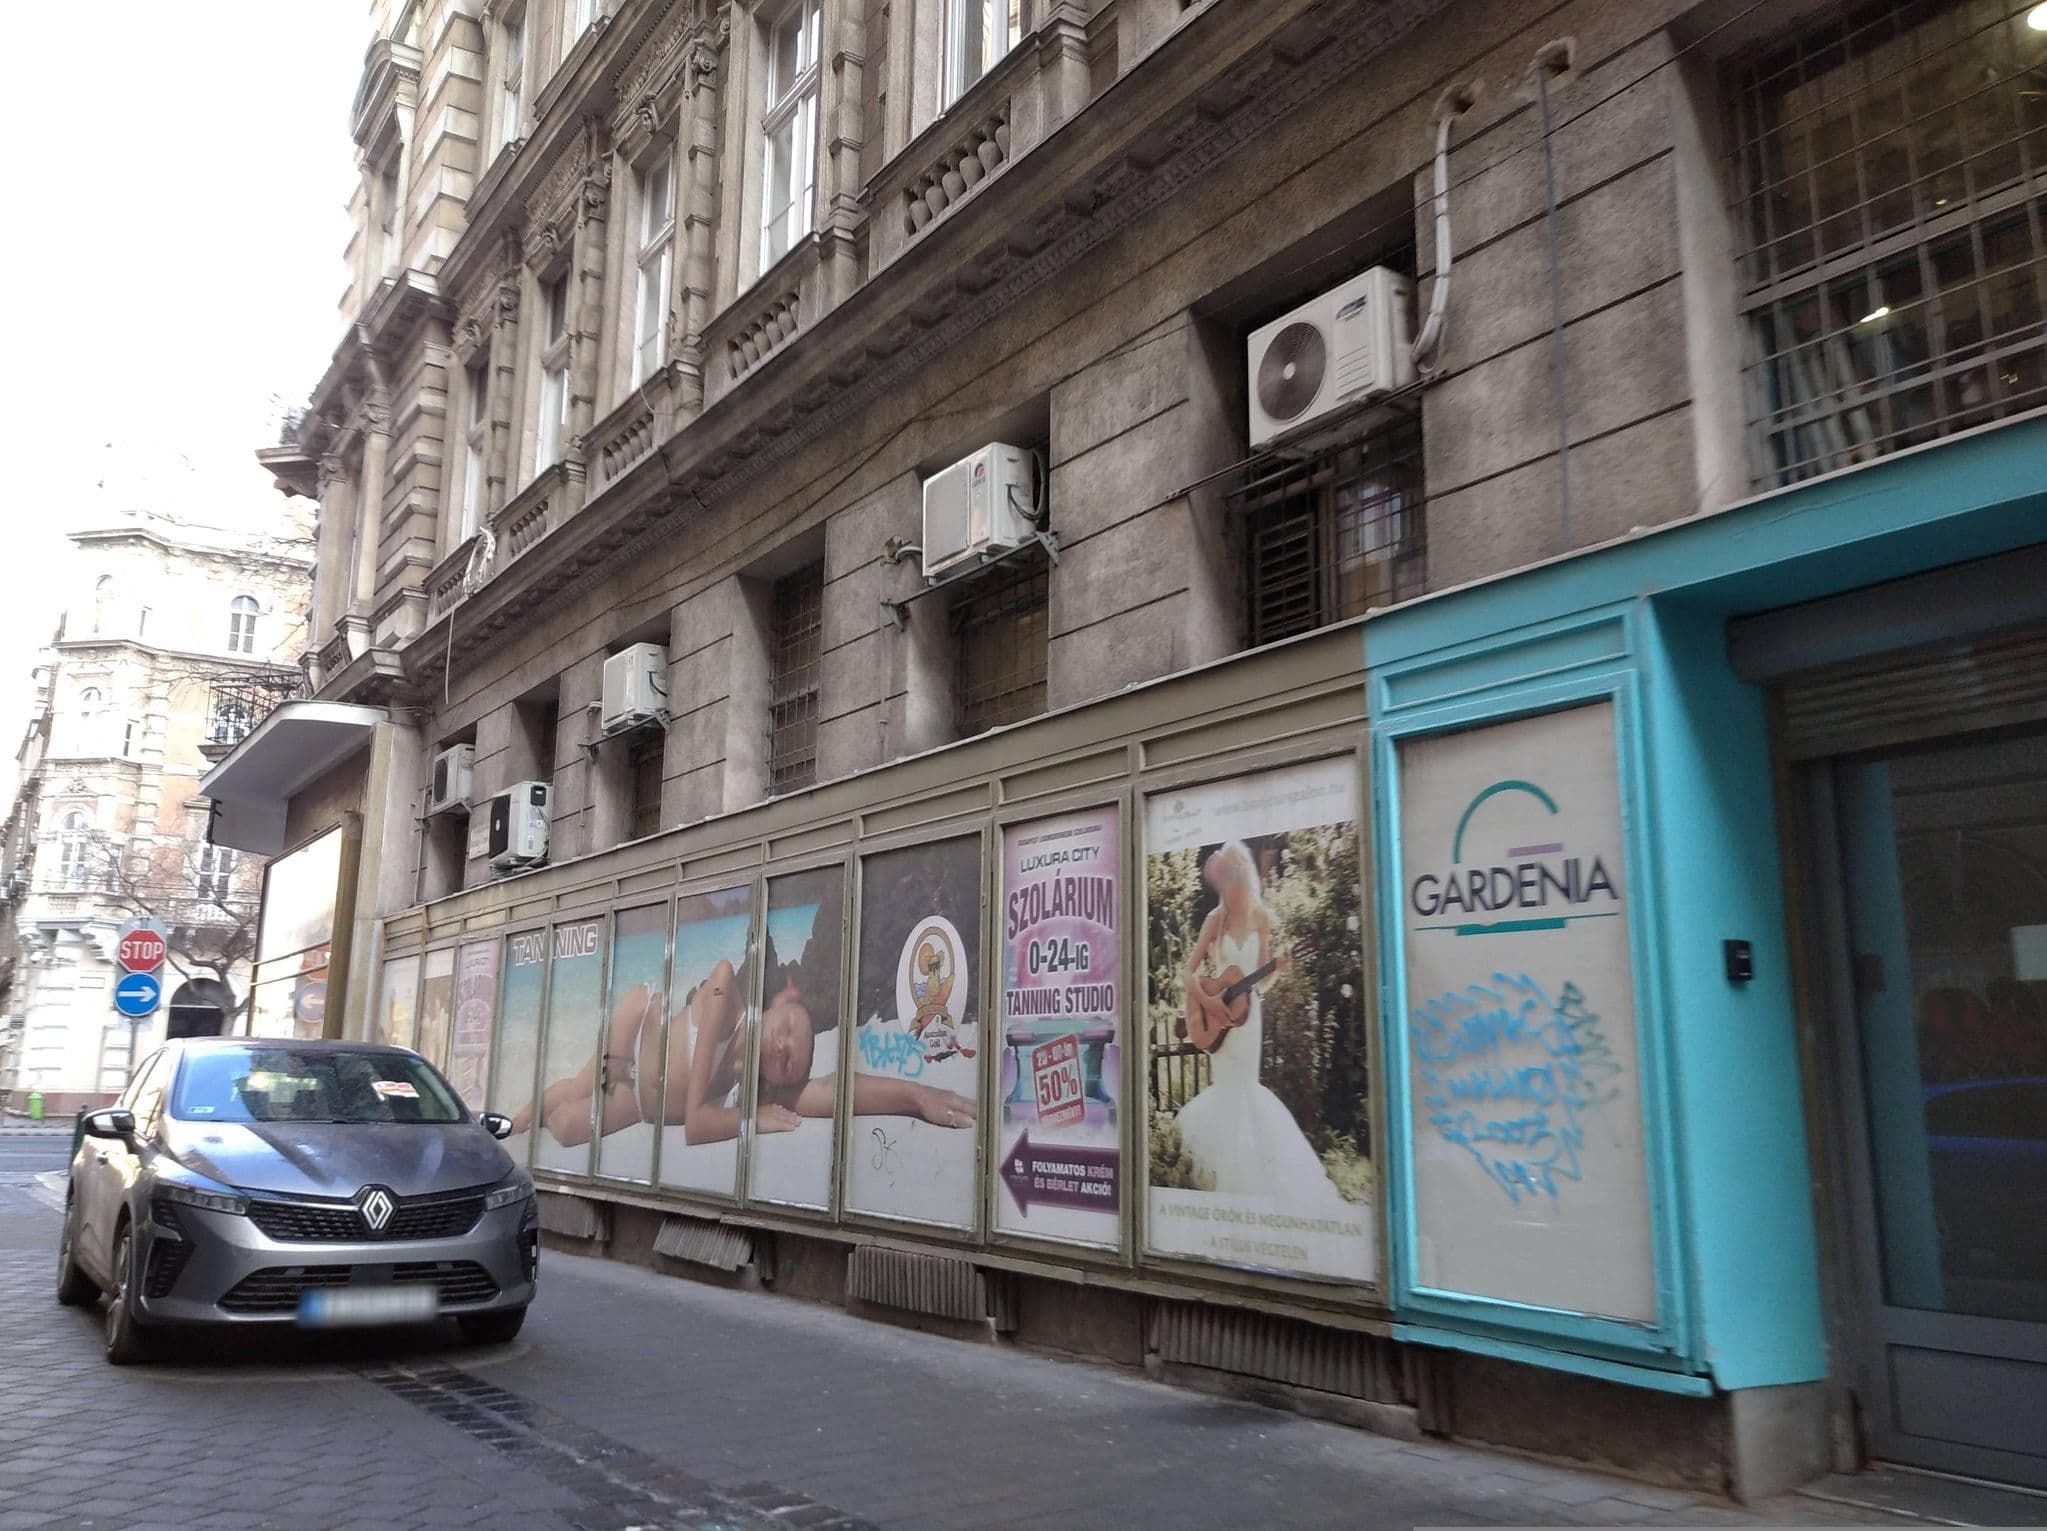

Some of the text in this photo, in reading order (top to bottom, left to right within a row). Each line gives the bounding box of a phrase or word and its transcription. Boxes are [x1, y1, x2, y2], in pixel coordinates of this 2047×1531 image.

[1020, 846, 1100, 873] LUXURA CITY
[1412, 855, 1619, 916] GARDENIA
[1008, 868, 1113, 940] SZOLÁRIUM
[120, 940, 164, 960] STOP
[1029, 938, 1089, 975] 0-24-IG
[1006, 984, 1114, 1016] TANNING STUDIO
[1039, 1063, 1078, 1105] 50%
[1032, 1161, 1114, 1179] FOLYAMATOS KRÉM
[1034, 1174, 1045, 1189] ÉS
[1046, 1176, 1079, 1192] BÉRLET
[1080, 1181, 1112, 1196] AKCIÓ!
